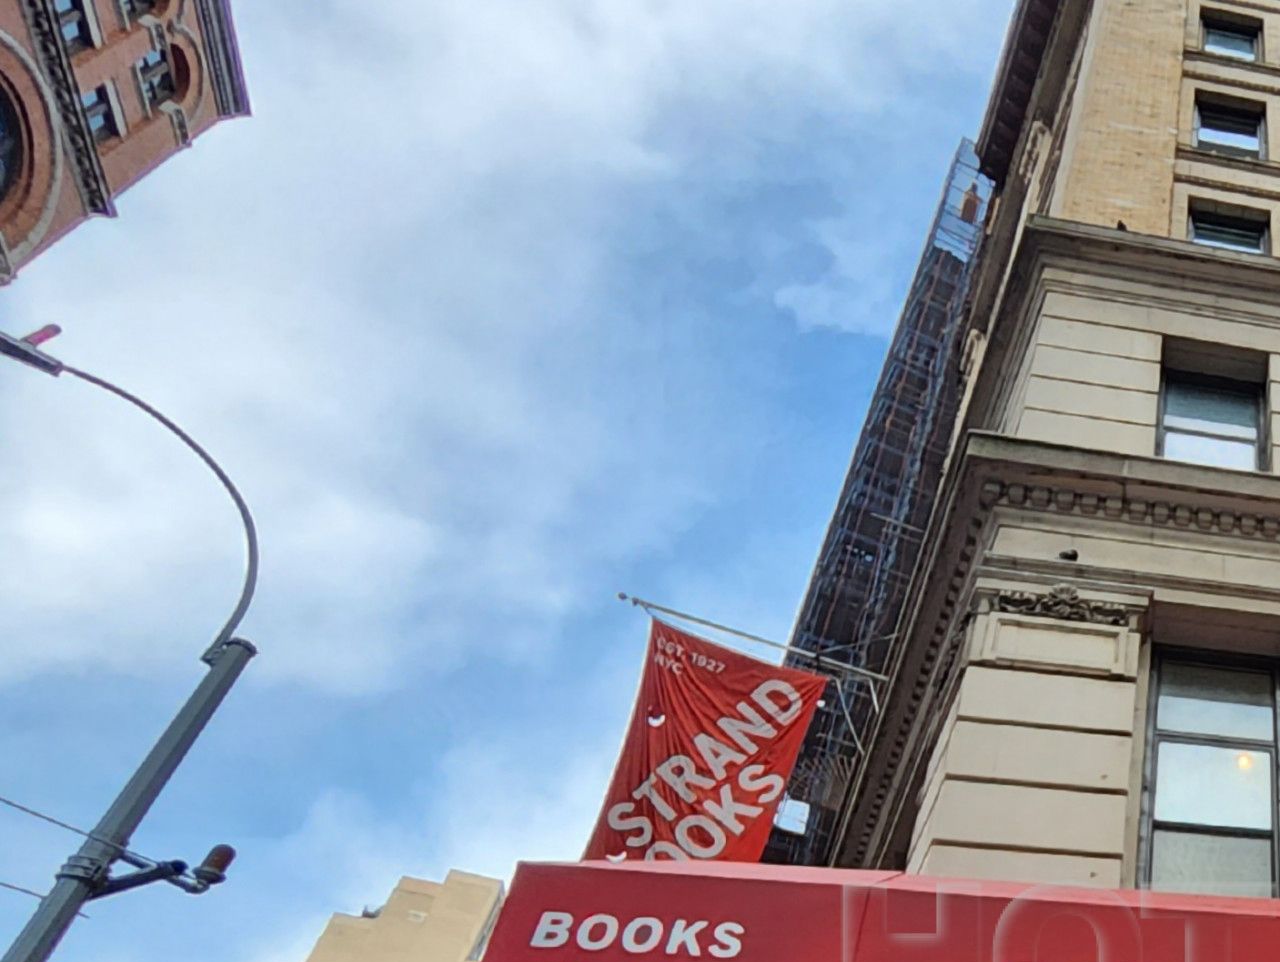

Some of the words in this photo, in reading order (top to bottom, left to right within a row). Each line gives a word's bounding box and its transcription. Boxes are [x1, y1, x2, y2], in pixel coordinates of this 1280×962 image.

[653, 654, 683, 676] NYC
[691, 652, 726, 674] 1927
[607, 679, 803, 848] STRAND
[530, 910, 745, 958] BOOKS
